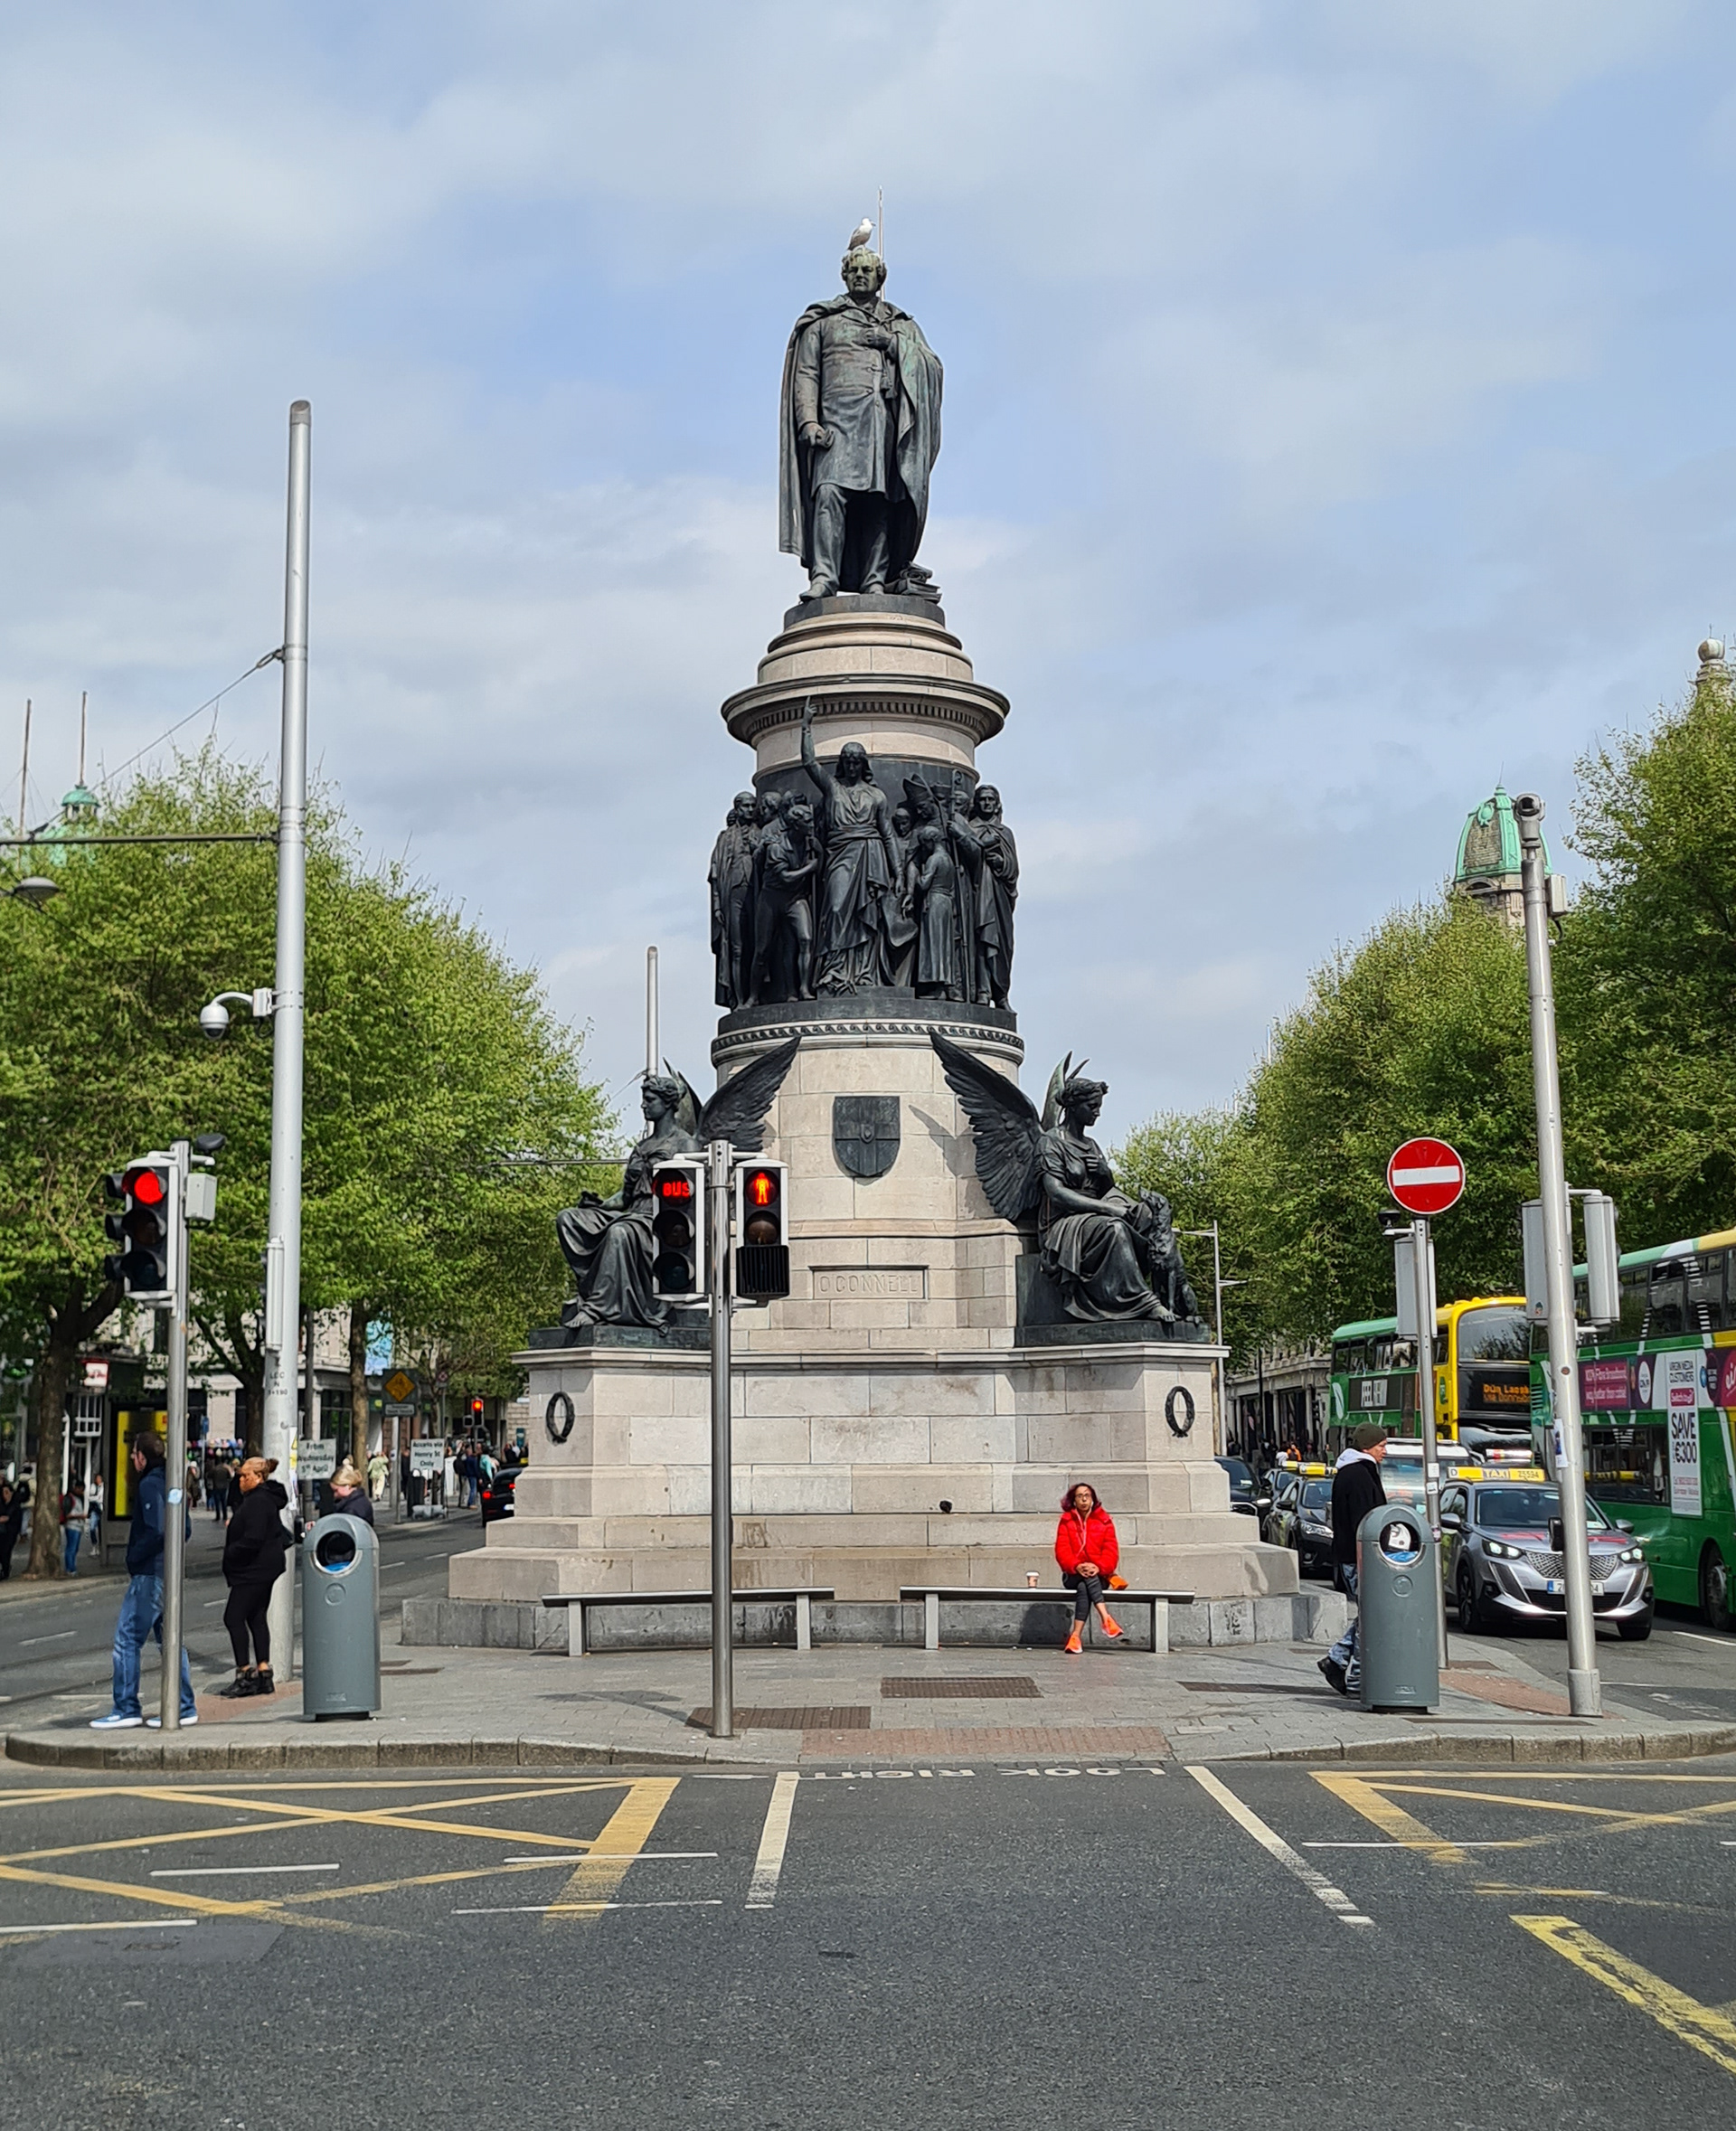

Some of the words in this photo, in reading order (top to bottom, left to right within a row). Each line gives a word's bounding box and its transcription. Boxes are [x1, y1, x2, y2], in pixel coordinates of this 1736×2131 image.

[663, 1181, 690, 1197] BUS
[1671, 1412, 1696, 1439] SAVE
[1675, 1442, 1696, 1463] €300
[1450, 1468, 1458, 1476] D
[1484, 1469, 1508, 1478] TAXI
[797, 1768, 976, 1780] RIGHT
[996, 1767, 1167, 1777] LOOK
